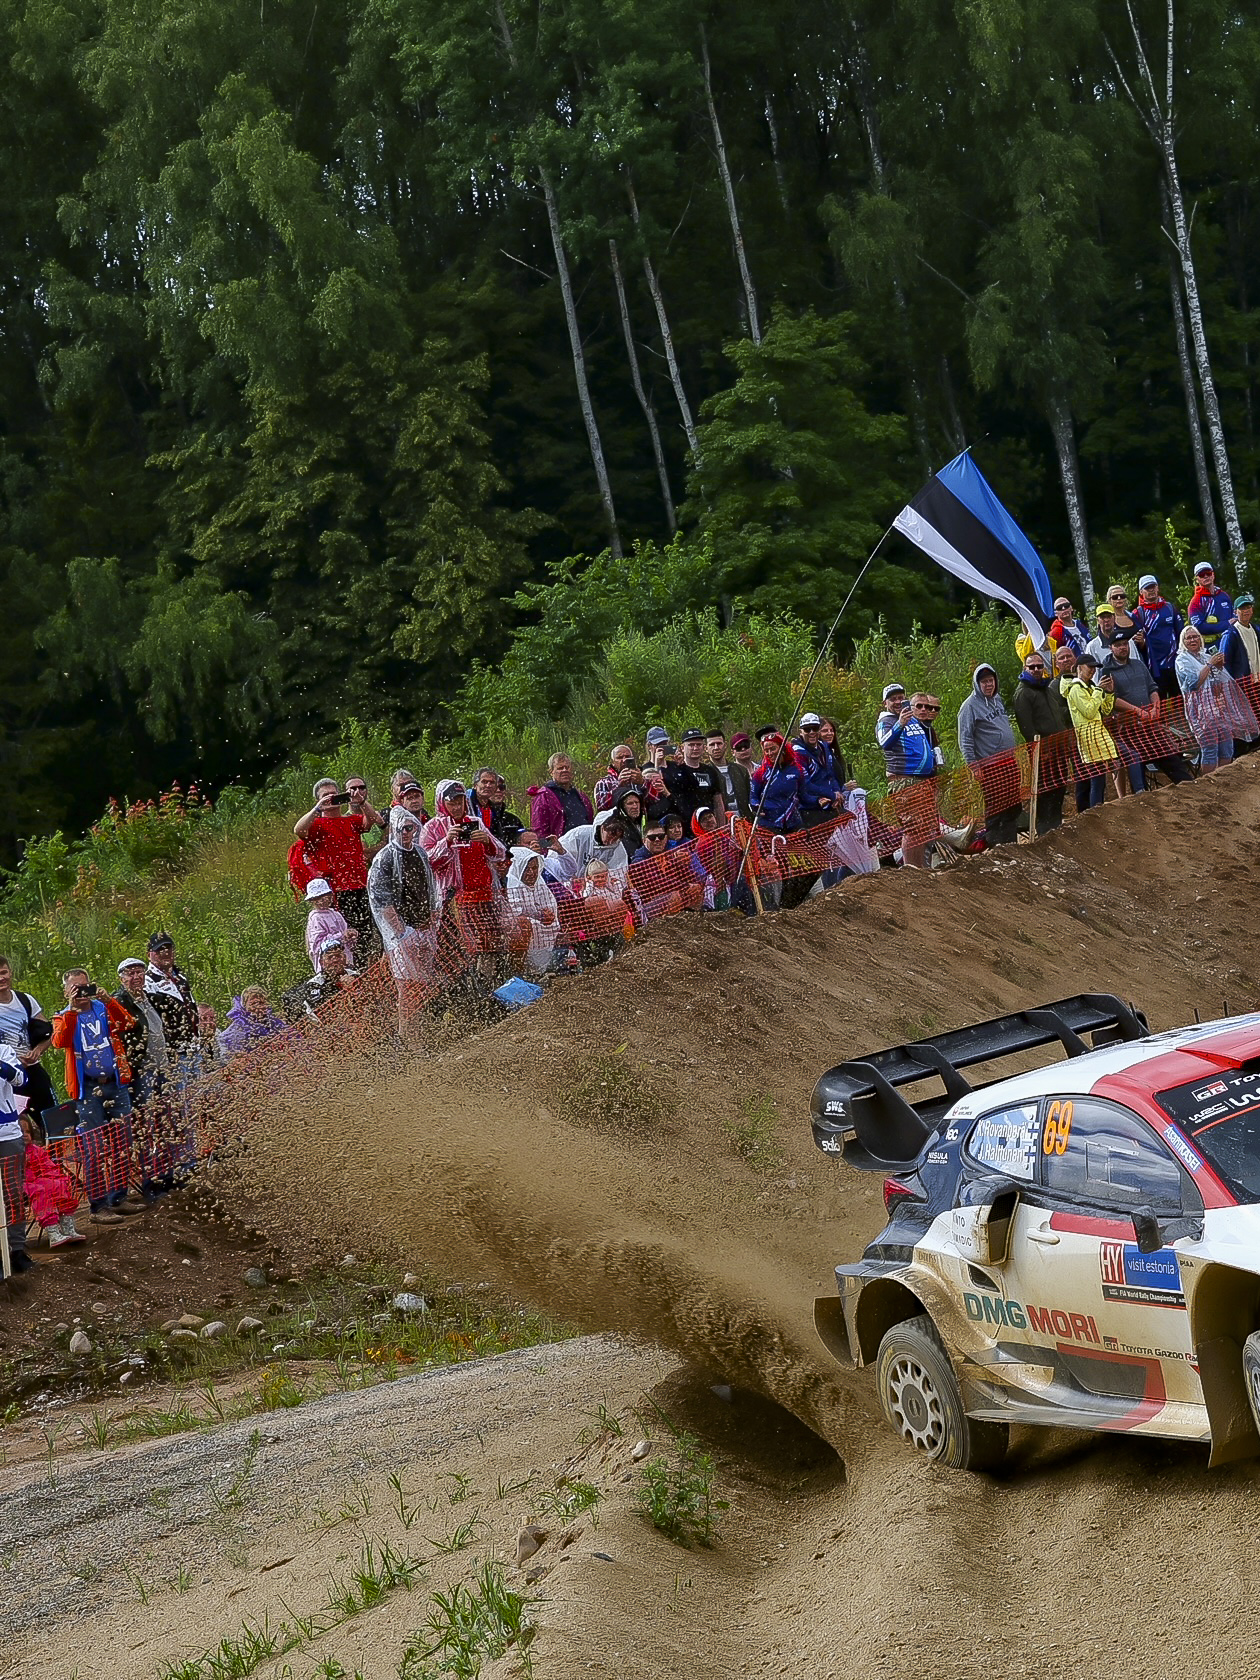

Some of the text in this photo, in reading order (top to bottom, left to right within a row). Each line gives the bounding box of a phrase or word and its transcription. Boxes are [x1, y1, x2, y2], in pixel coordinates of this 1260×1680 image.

[1043, 1100, 1074, 1156] 69
[1128, 1258, 1175, 1275] visit estonia
[963, 1292, 1101, 1344] DMG MORI
[1120, 1343, 1154, 1356] TOYOTA
[1154, 1348, 1184, 1360] GAZOO
